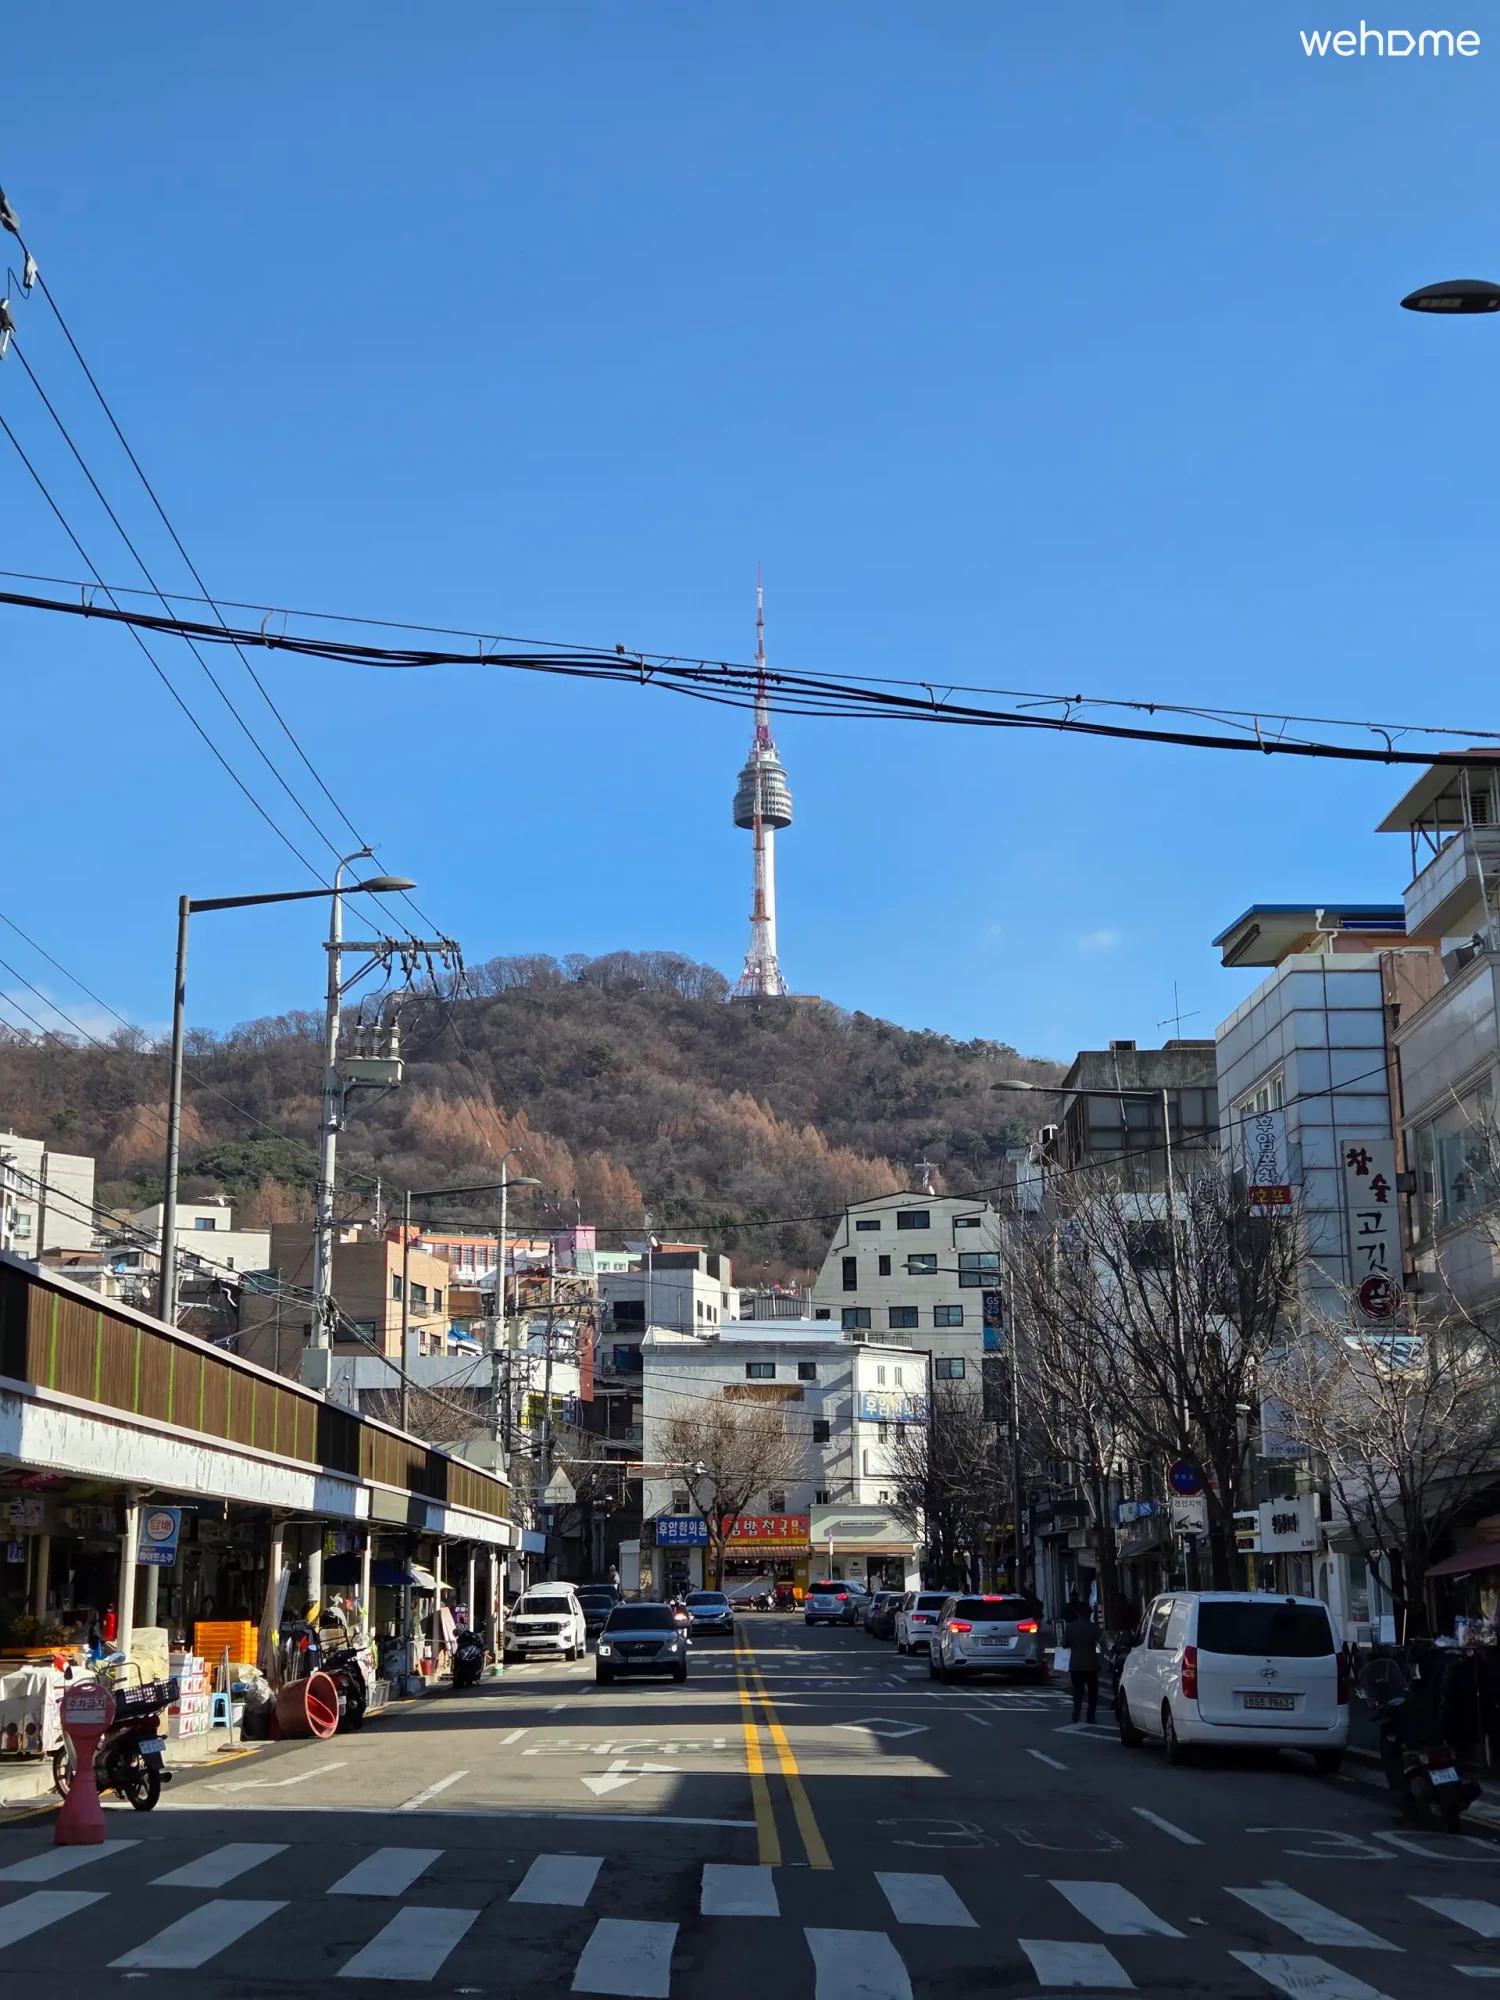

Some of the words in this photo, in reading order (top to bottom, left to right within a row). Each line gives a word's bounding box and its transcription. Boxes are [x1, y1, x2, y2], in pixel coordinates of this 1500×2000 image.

[1255, 1114, 1279, 1184] 후암포차
[986, 1296, 1000, 1305] GS
[986, 1305, 1000, 1314] 25
[1174, 1499, 1202, 1508] 견인지역
[150, 1519, 172, 1531] 담배
[658, 1520, 707, 1537] 후암한의원
[68, 1696, 105, 1710] 주차금지
